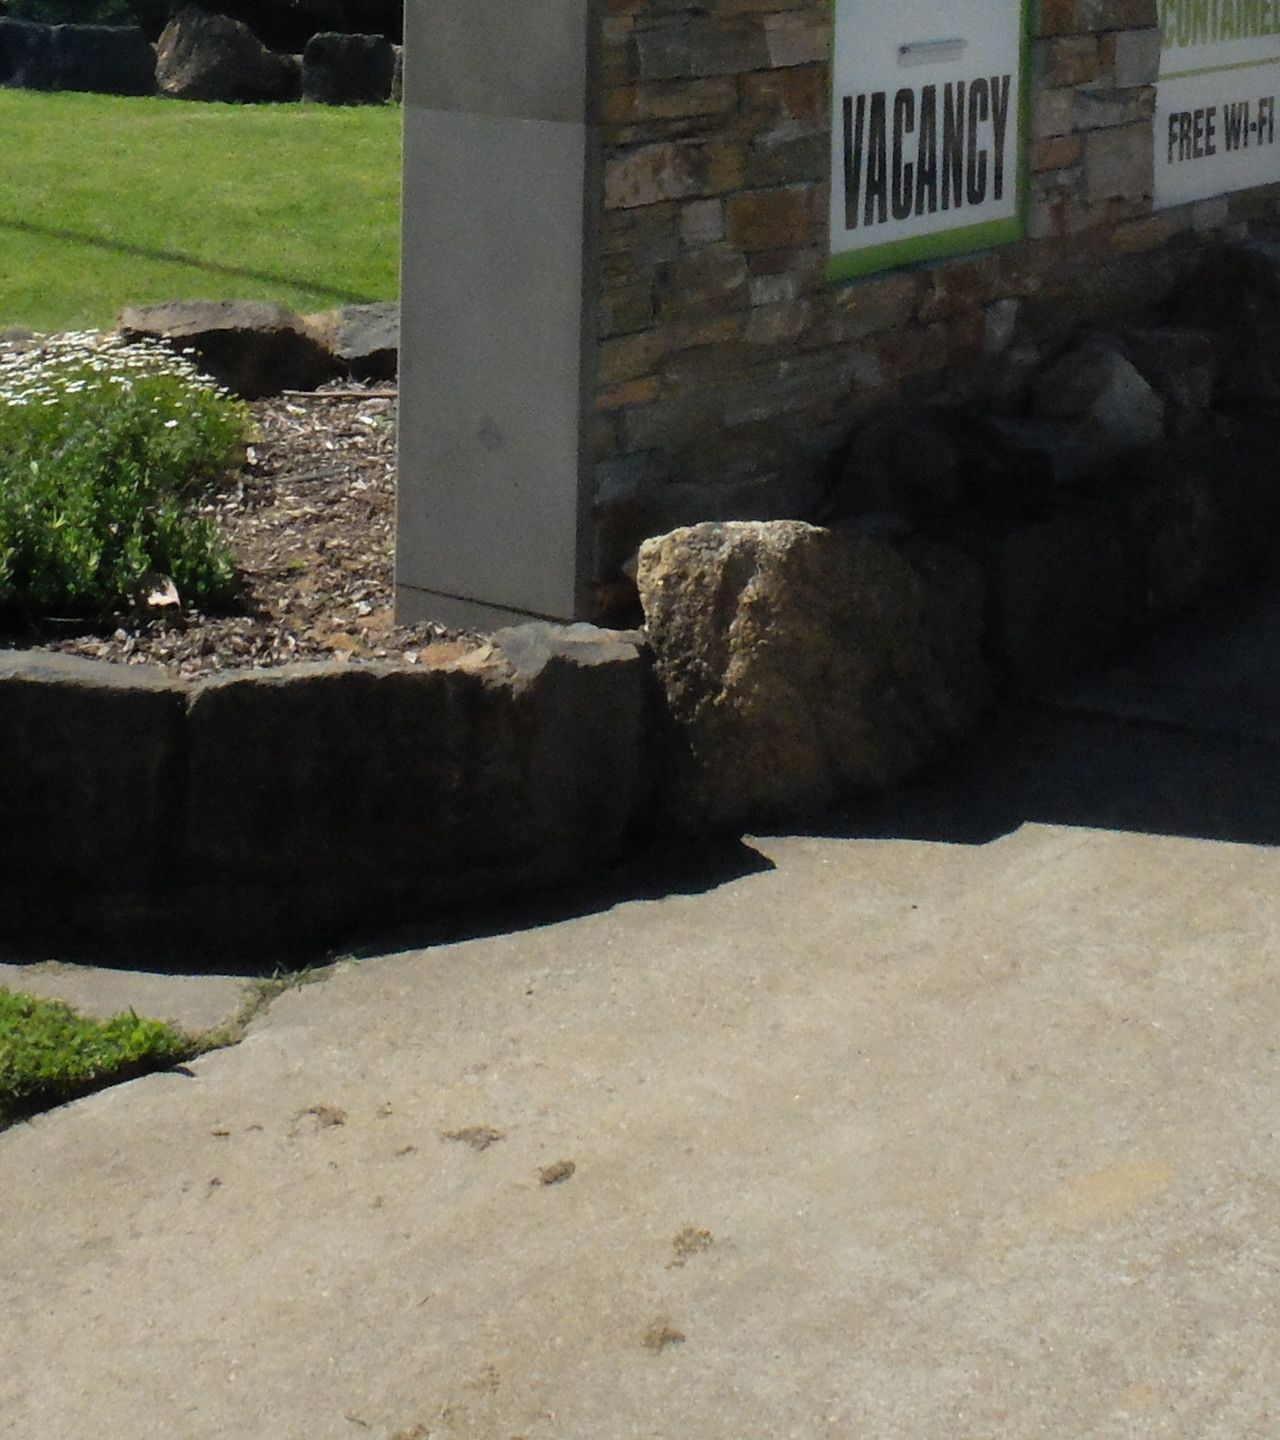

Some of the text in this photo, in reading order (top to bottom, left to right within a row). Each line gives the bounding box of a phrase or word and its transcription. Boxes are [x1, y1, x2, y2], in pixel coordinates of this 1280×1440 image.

[843, 75, 1011, 231] VACANCY
[1167, 95, 1275, 164] FREE WI-FI
